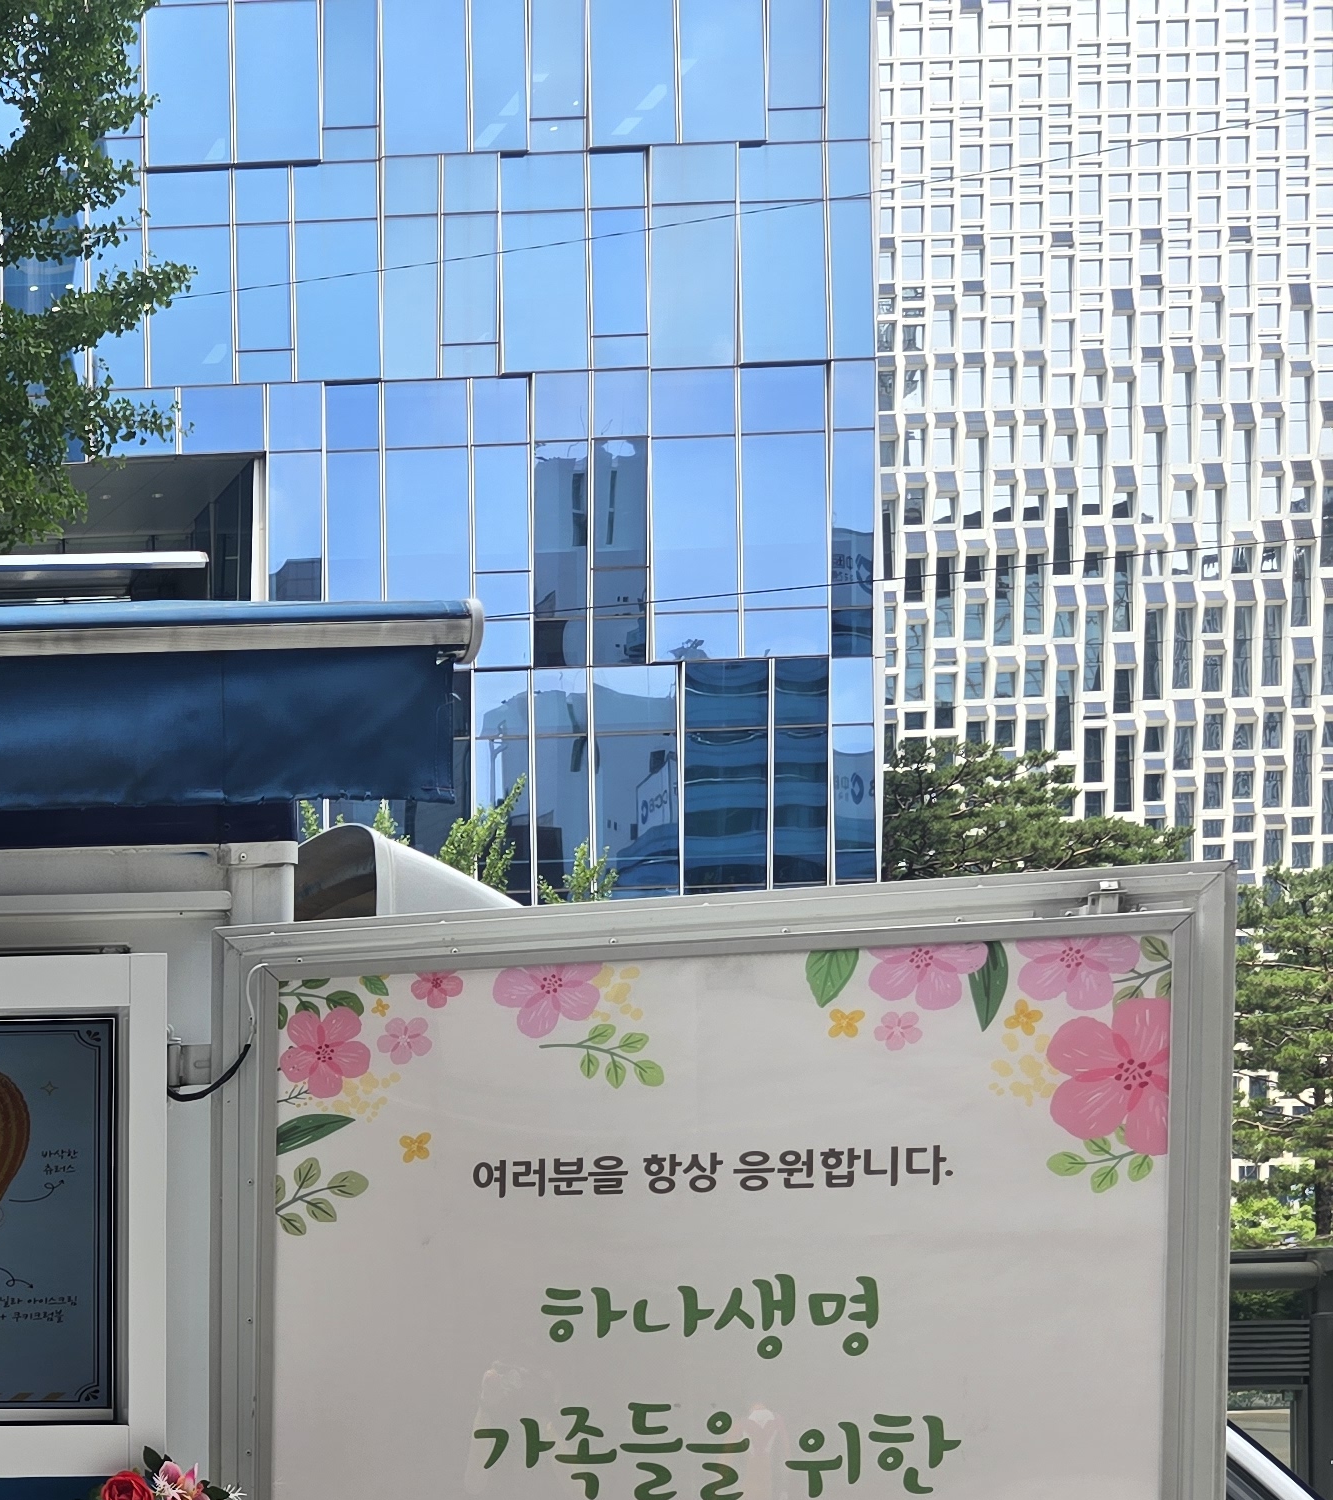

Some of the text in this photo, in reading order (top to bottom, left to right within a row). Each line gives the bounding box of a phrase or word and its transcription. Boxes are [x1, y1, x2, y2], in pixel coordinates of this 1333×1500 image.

[472, 1144, 955, 1198] 여러분을 항상 응원합니다.
[540, 1273, 881, 1360] 하나생명
[785, 1413, 963, 1499] 위한
